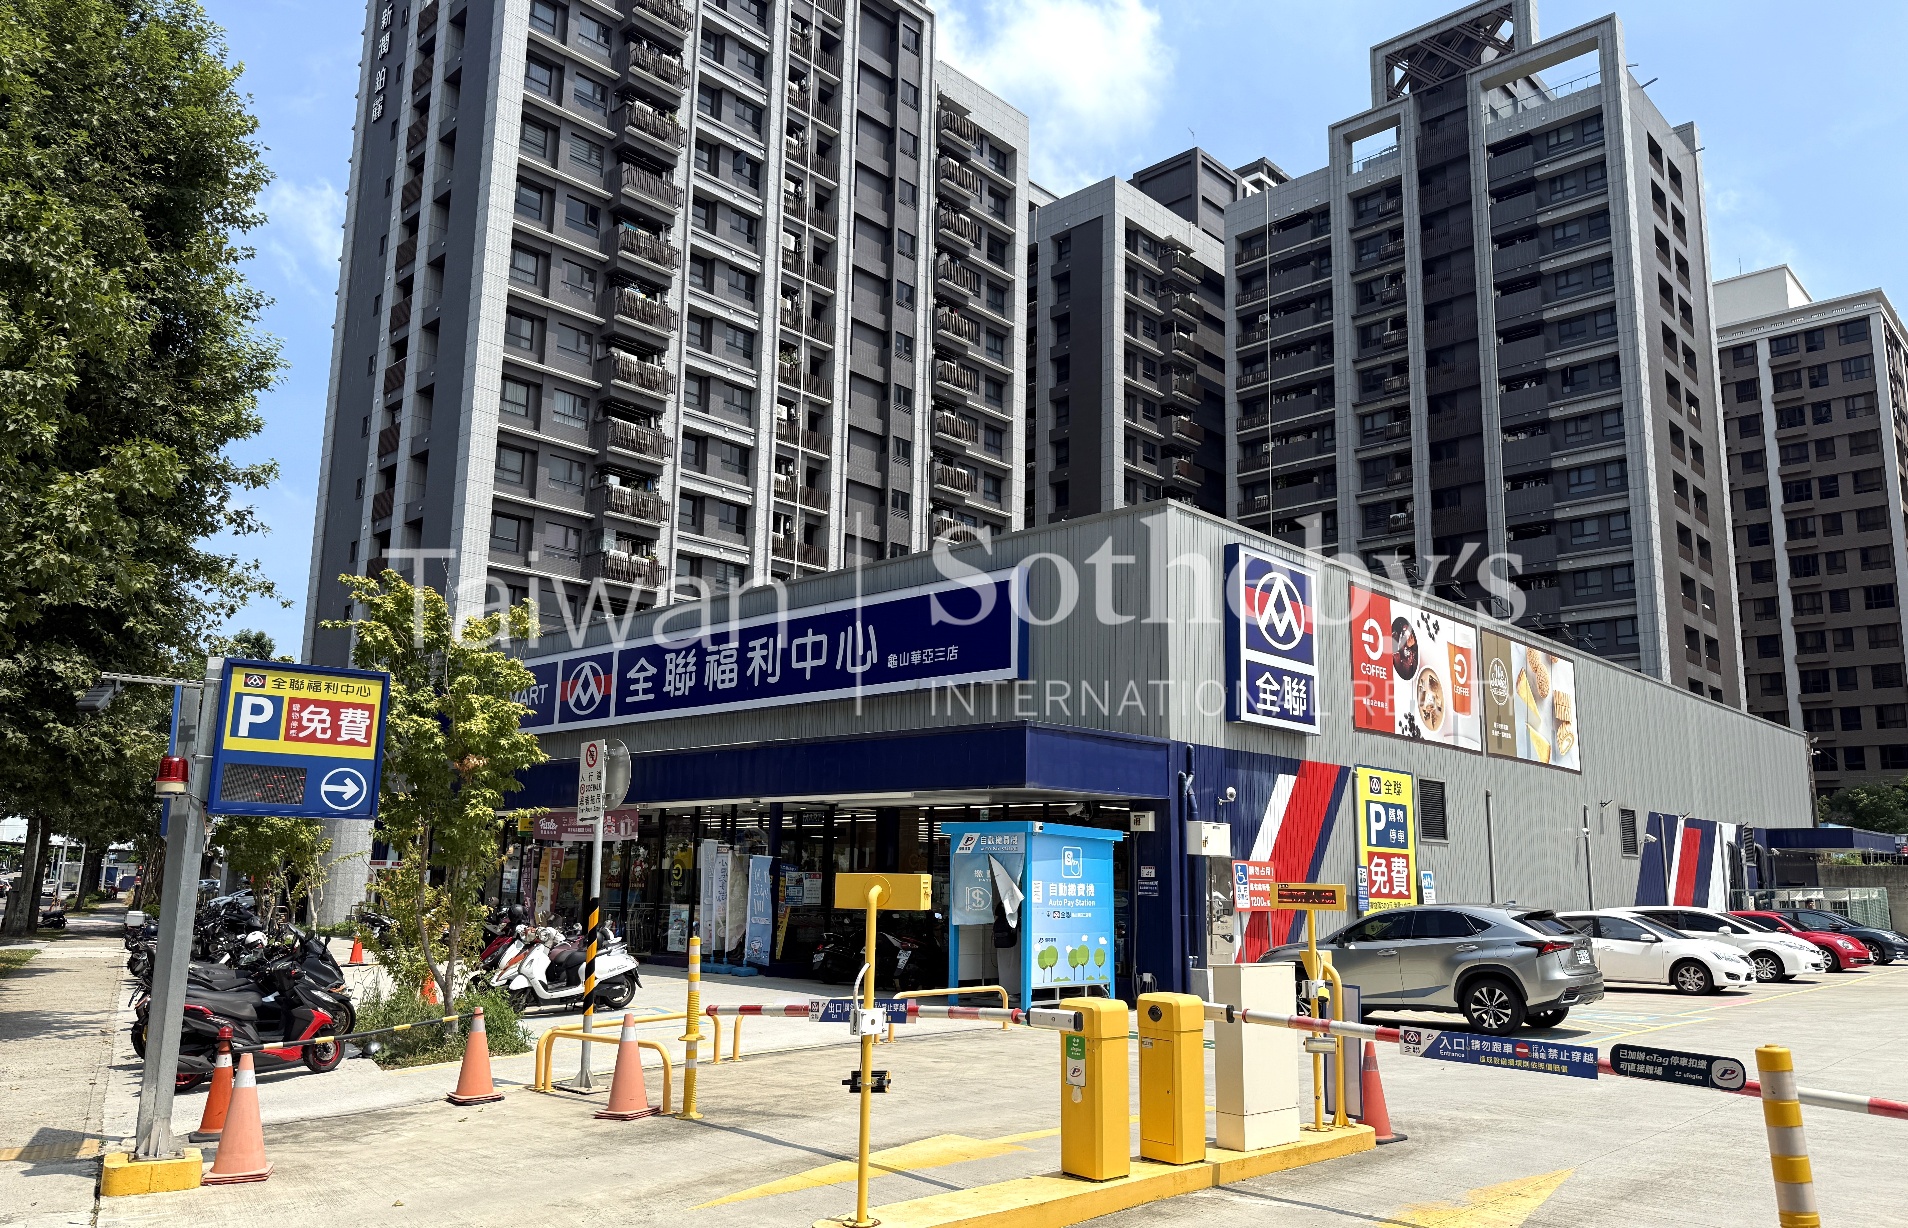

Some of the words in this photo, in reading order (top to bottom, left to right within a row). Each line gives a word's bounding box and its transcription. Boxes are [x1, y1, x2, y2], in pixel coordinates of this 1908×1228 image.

[626, 620, 878, 704] 全聯福利中心
[1360, 662, 1388, 680] COFFEE
[271, 677, 371, 698] 全聯福利中心
[1255, 671, 1307, 717] 全聯
[1453, 685, 1470, 697] COFFEE
[237, 695, 274, 737] P
[298, 704, 371, 744] 免費
[1383, 779, 1402, 796] 全聯
[1369, 802, 1387, 845] P
[1388, 808, 1404, 823] 購物
[1389, 828, 1405, 844] 停車
[1369, 855, 1410, 896] 免費
[1049, 882, 1095, 897] 自動繳費機
[1049, 898, 1063, 907] Auto
[1063, 898, 1075, 908] Pay
[1075, 898, 1096, 907] Station
[828, 1002, 842, 1013] 出口
[1439, 1036, 1465, 1051] 入口
[1470, 1039, 1513, 1055] 請勿跟車
[1532, 1044, 1546, 1053] 行人
[1439, 1049, 1465, 1058] Entrance
[1547, 1047, 1595, 1064] 禁止穿越
[1619, 1049, 1646, 1062] 已加辦
[1646, 1053, 1669, 1066] eTag
